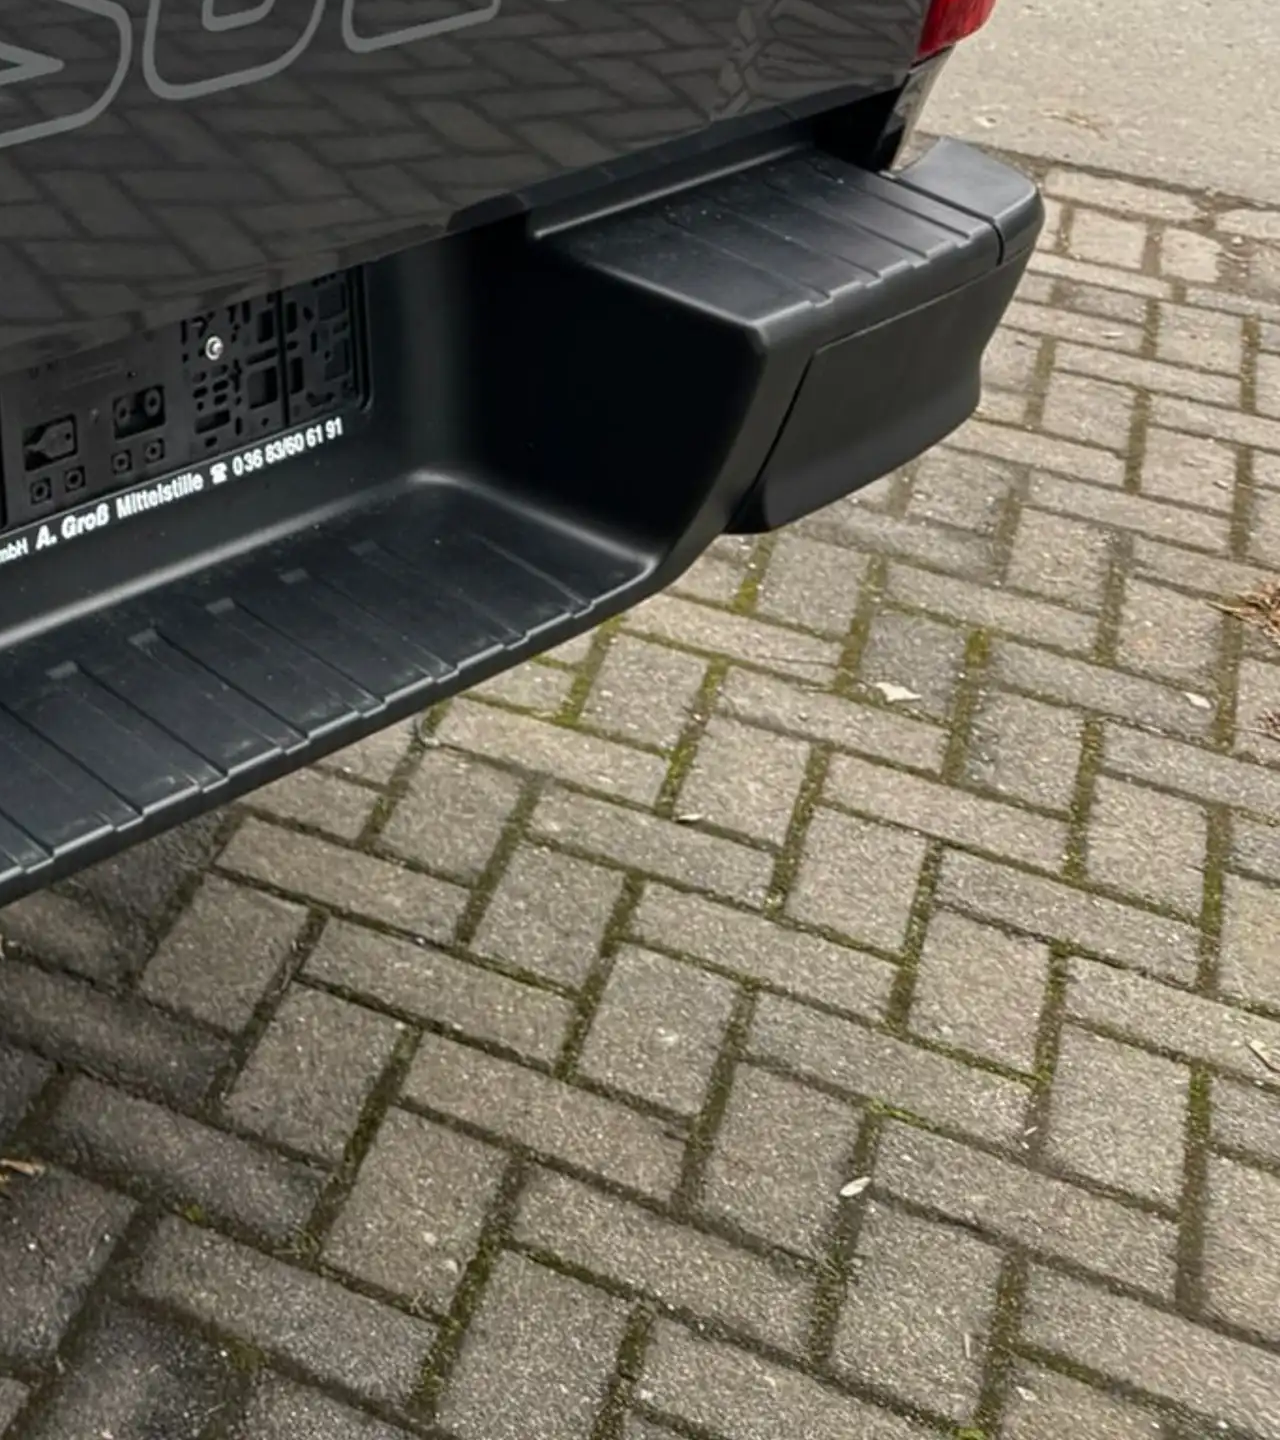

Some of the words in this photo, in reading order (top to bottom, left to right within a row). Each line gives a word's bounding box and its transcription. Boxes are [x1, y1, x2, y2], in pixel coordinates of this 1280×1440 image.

[35, 524, 58, 550] A.
[115, 472, 204, 520] Mittelstille
[306, 424, 323, 449] 61
[325, 416, 343, 440] 91
